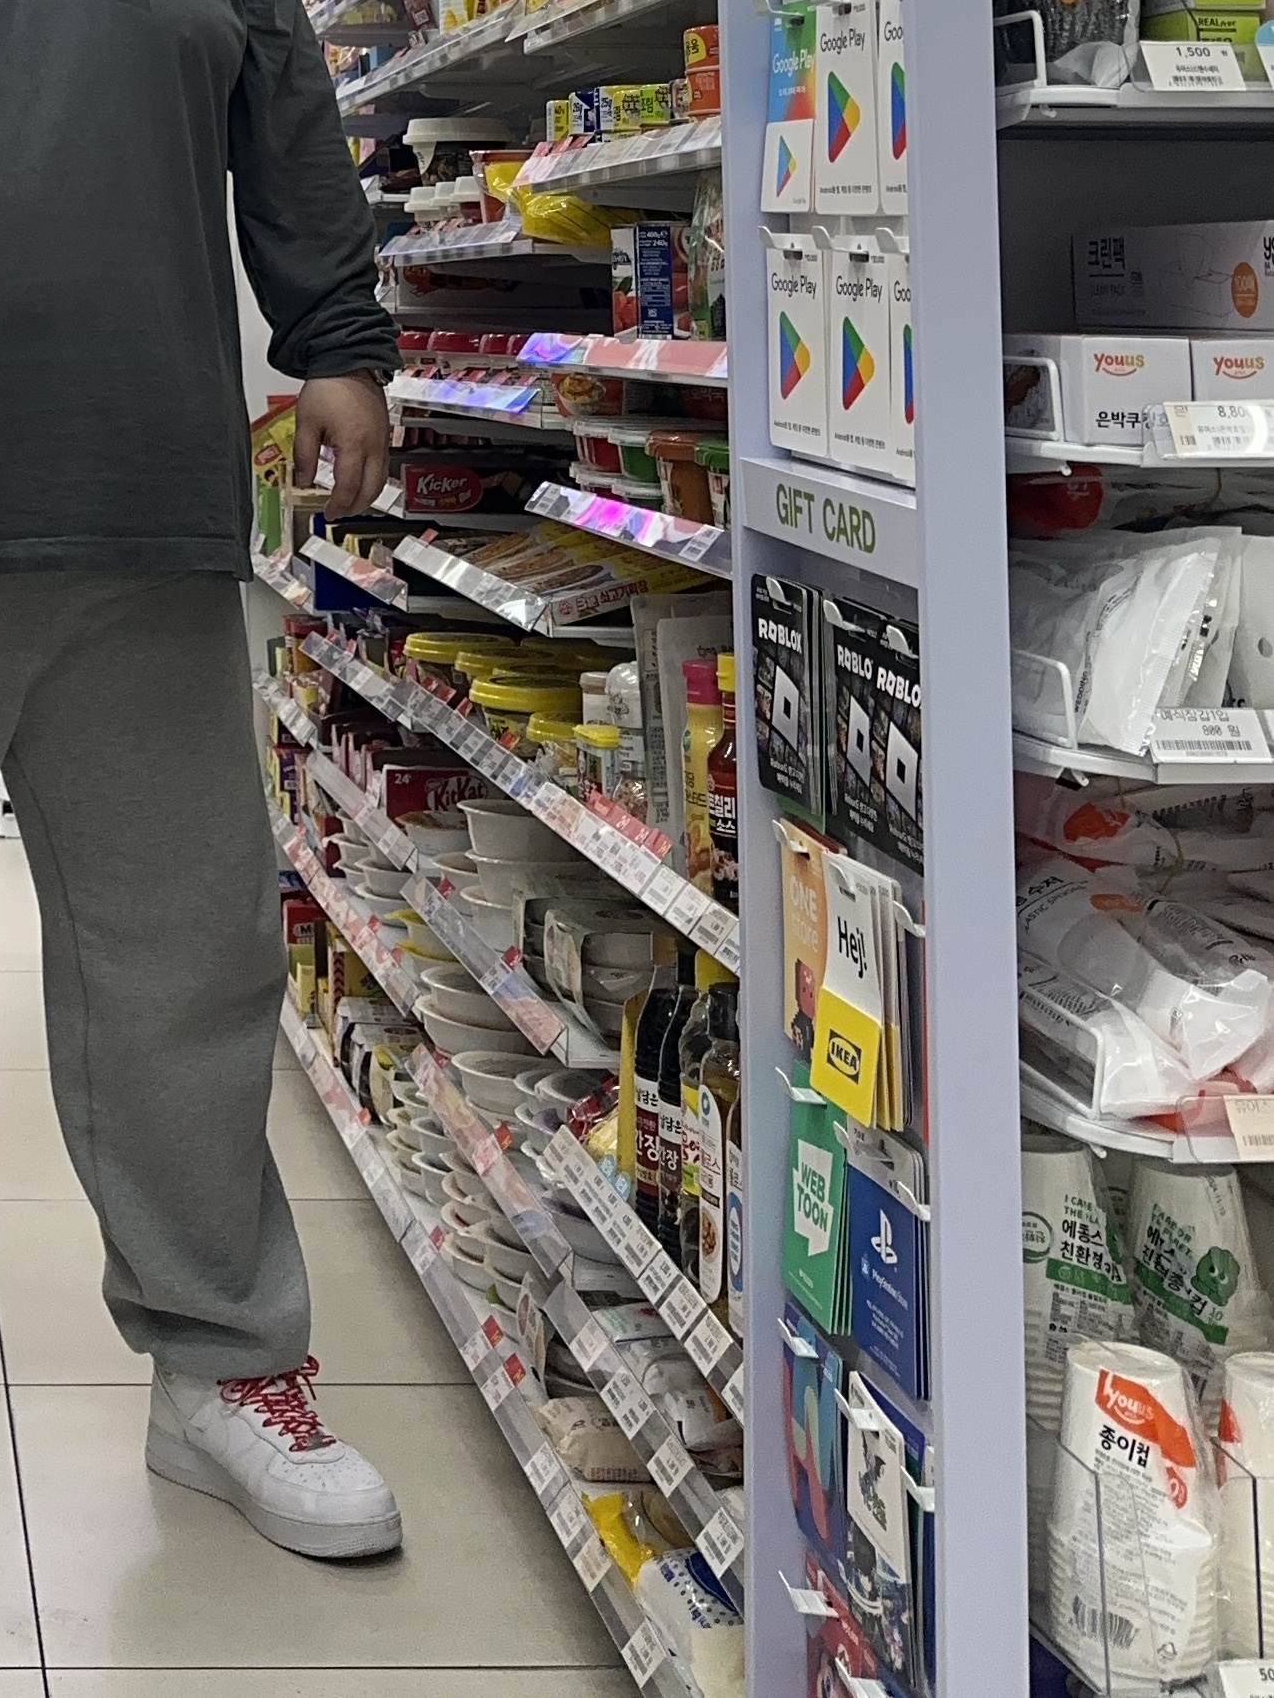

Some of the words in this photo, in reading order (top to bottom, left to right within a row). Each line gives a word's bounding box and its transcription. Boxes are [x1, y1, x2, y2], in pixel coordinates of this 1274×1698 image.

[820, 30, 847, 55] Google
[849, 28, 865, 51] Play
[884, 21, 903, 42] Goo
[773, 51, 799, 76] Google
[800, 48, 815, 73] Play
[1176, 47, 1210, 58] 1,500
[771, 273, 798, 298] Google
[800, 275, 817, 300] Play
[836, 275, 863, 302] Google
[865, 278, 883, 303] Play
[894, 281, 911, 303] Goo
[1094, 353, 1145, 373] youus
[1213, 356, 1265, 376] youus
[417, 473, 467, 495] Kicker
[776, 482, 815, 534] GIFT
[823, 497, 876, 554] CARD
[758, 618, 802, 654] ROBLOX
[837, 644, 874, 680] ROBLO
[877, 666, 921, 709] ROBLO
[1202, 725, 1222, 736] 800
[434, 778, 485, 812] KitKat
[789, 876, 818, 922] ONE
[837, 915, 867, 978] Hej!
[830, 1041, 858, 1072] IKEA
[800, 1162, 825, 1203] WEB
[797, 1185, 829, 1232] TOON
[1099, 1425, 1150, 1469] 종이컵
